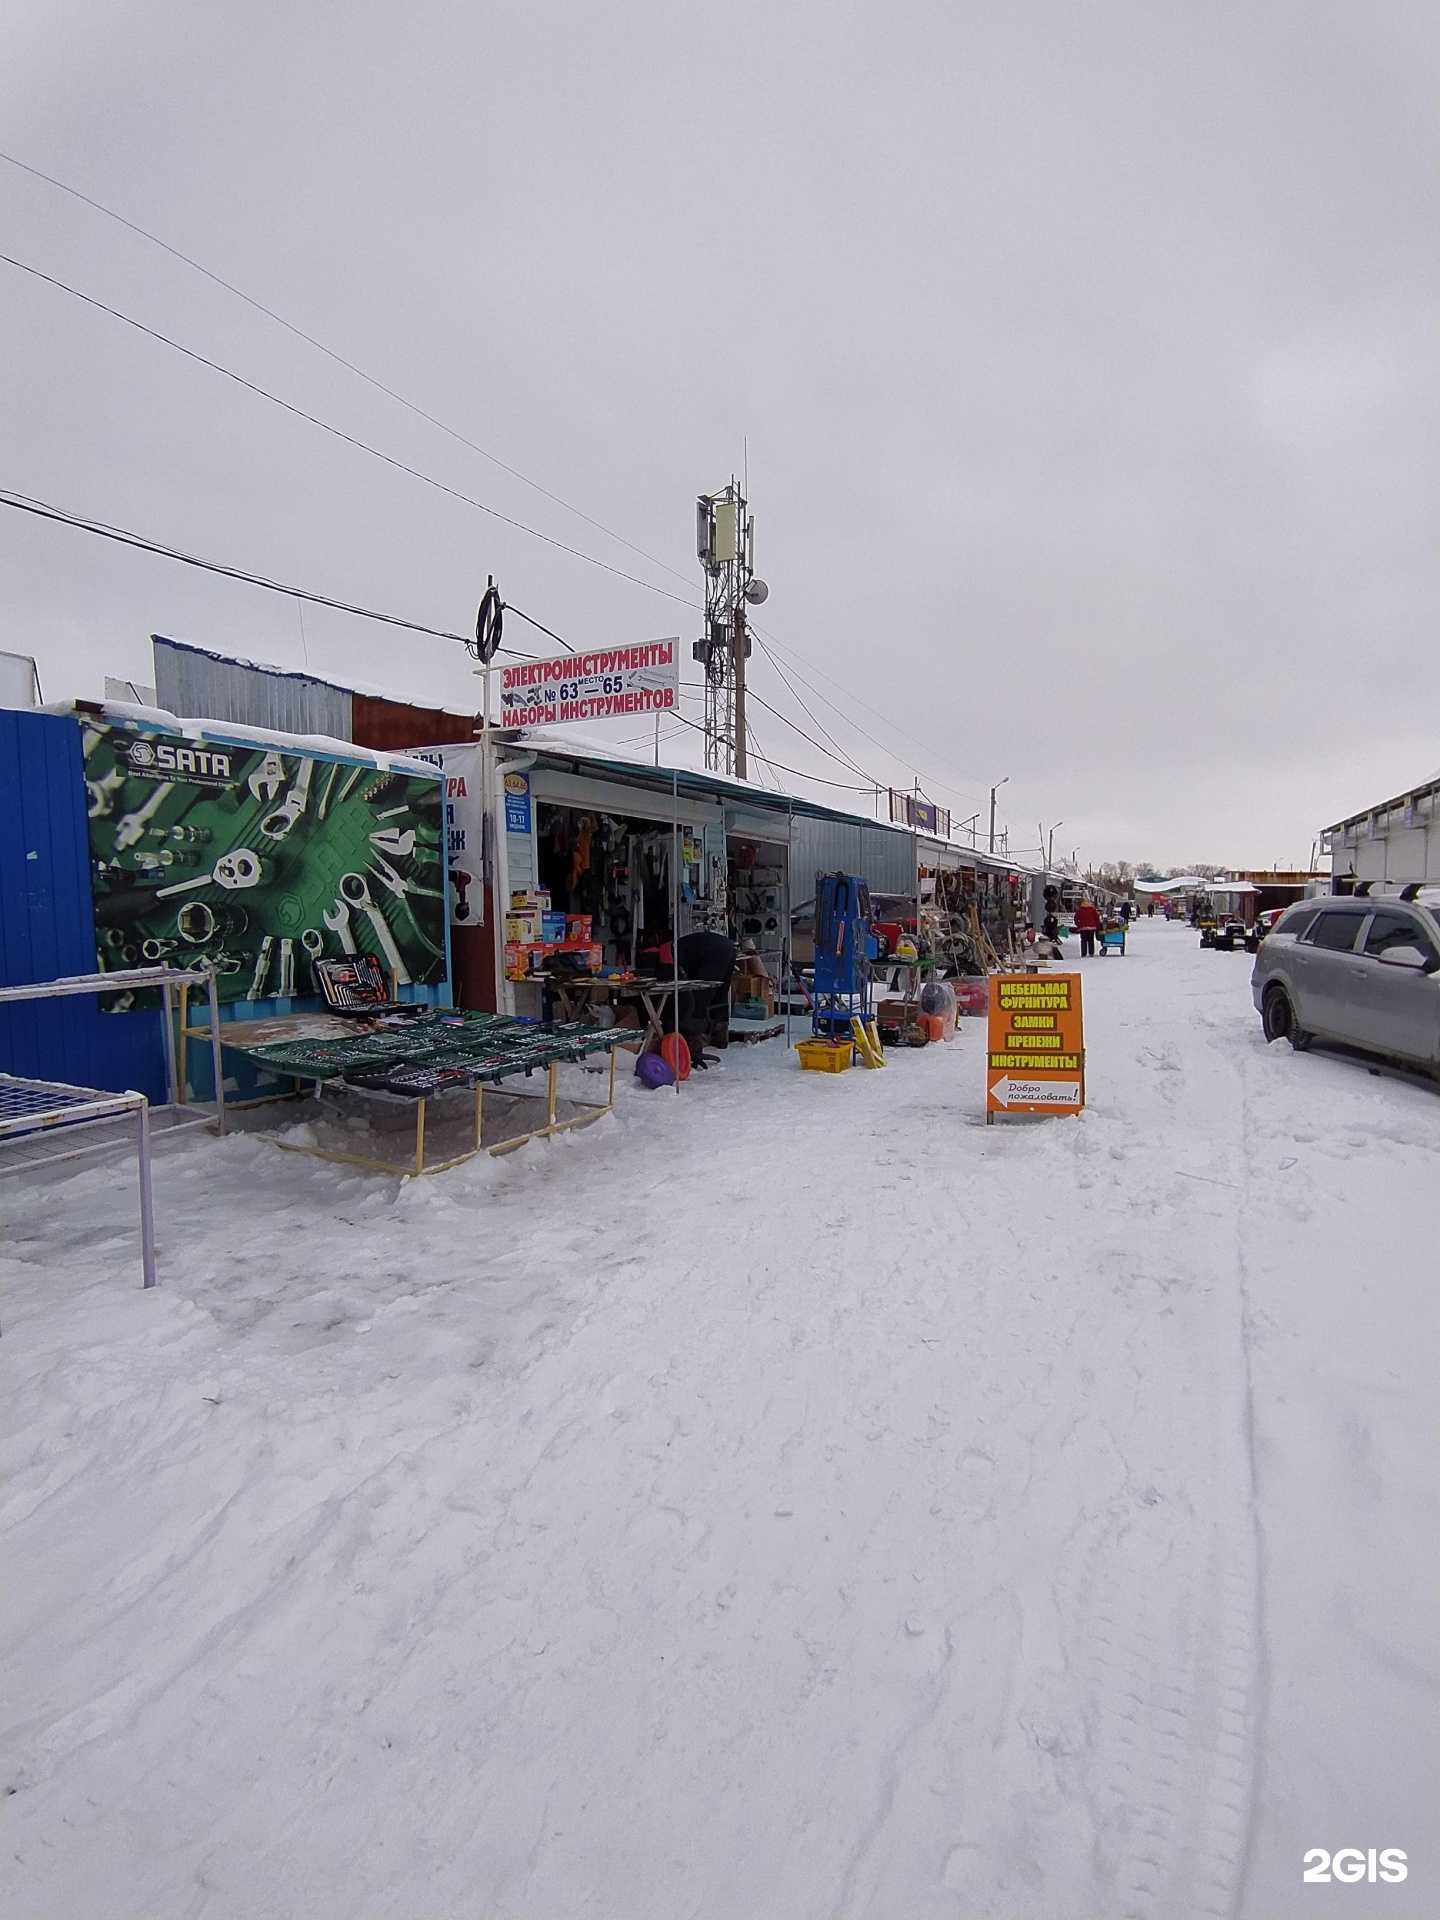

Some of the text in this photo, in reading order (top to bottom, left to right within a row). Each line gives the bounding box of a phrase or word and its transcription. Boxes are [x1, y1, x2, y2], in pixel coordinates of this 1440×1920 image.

[503, 642, 673, 688] ЭЛЕКТРОИНСТРУМЕНТЫ
[578, 675, 604, 685] МЕСТО
[544, 689, 556, 703] №
[559, 682, 579, 700] 63
[602, 676, 623, 694] 65
[502, 688, 674, 727] НАБОРЫ ИНСТРУМЕНТОВ
[157, 745, 230, 776] SATA
[446, 777, 467, 798] РА
[1000, 983, 1068, 995] МЕБЕЛЬНАЯ
[1000, 996, 1068, 1009] ФУРНИТУРА
[1013, 1016, 1054, 1028] ЗАМКИ
[1007, 1035, 1061, 1048] КРЕПЕЖИ
[991, 1054, 1078, 1068] ИНСТРУМЕНТЫ
[1008, 1083, 1041, 1094] Добро
[1007, 1089, 1078, 1102] пожаловать!
